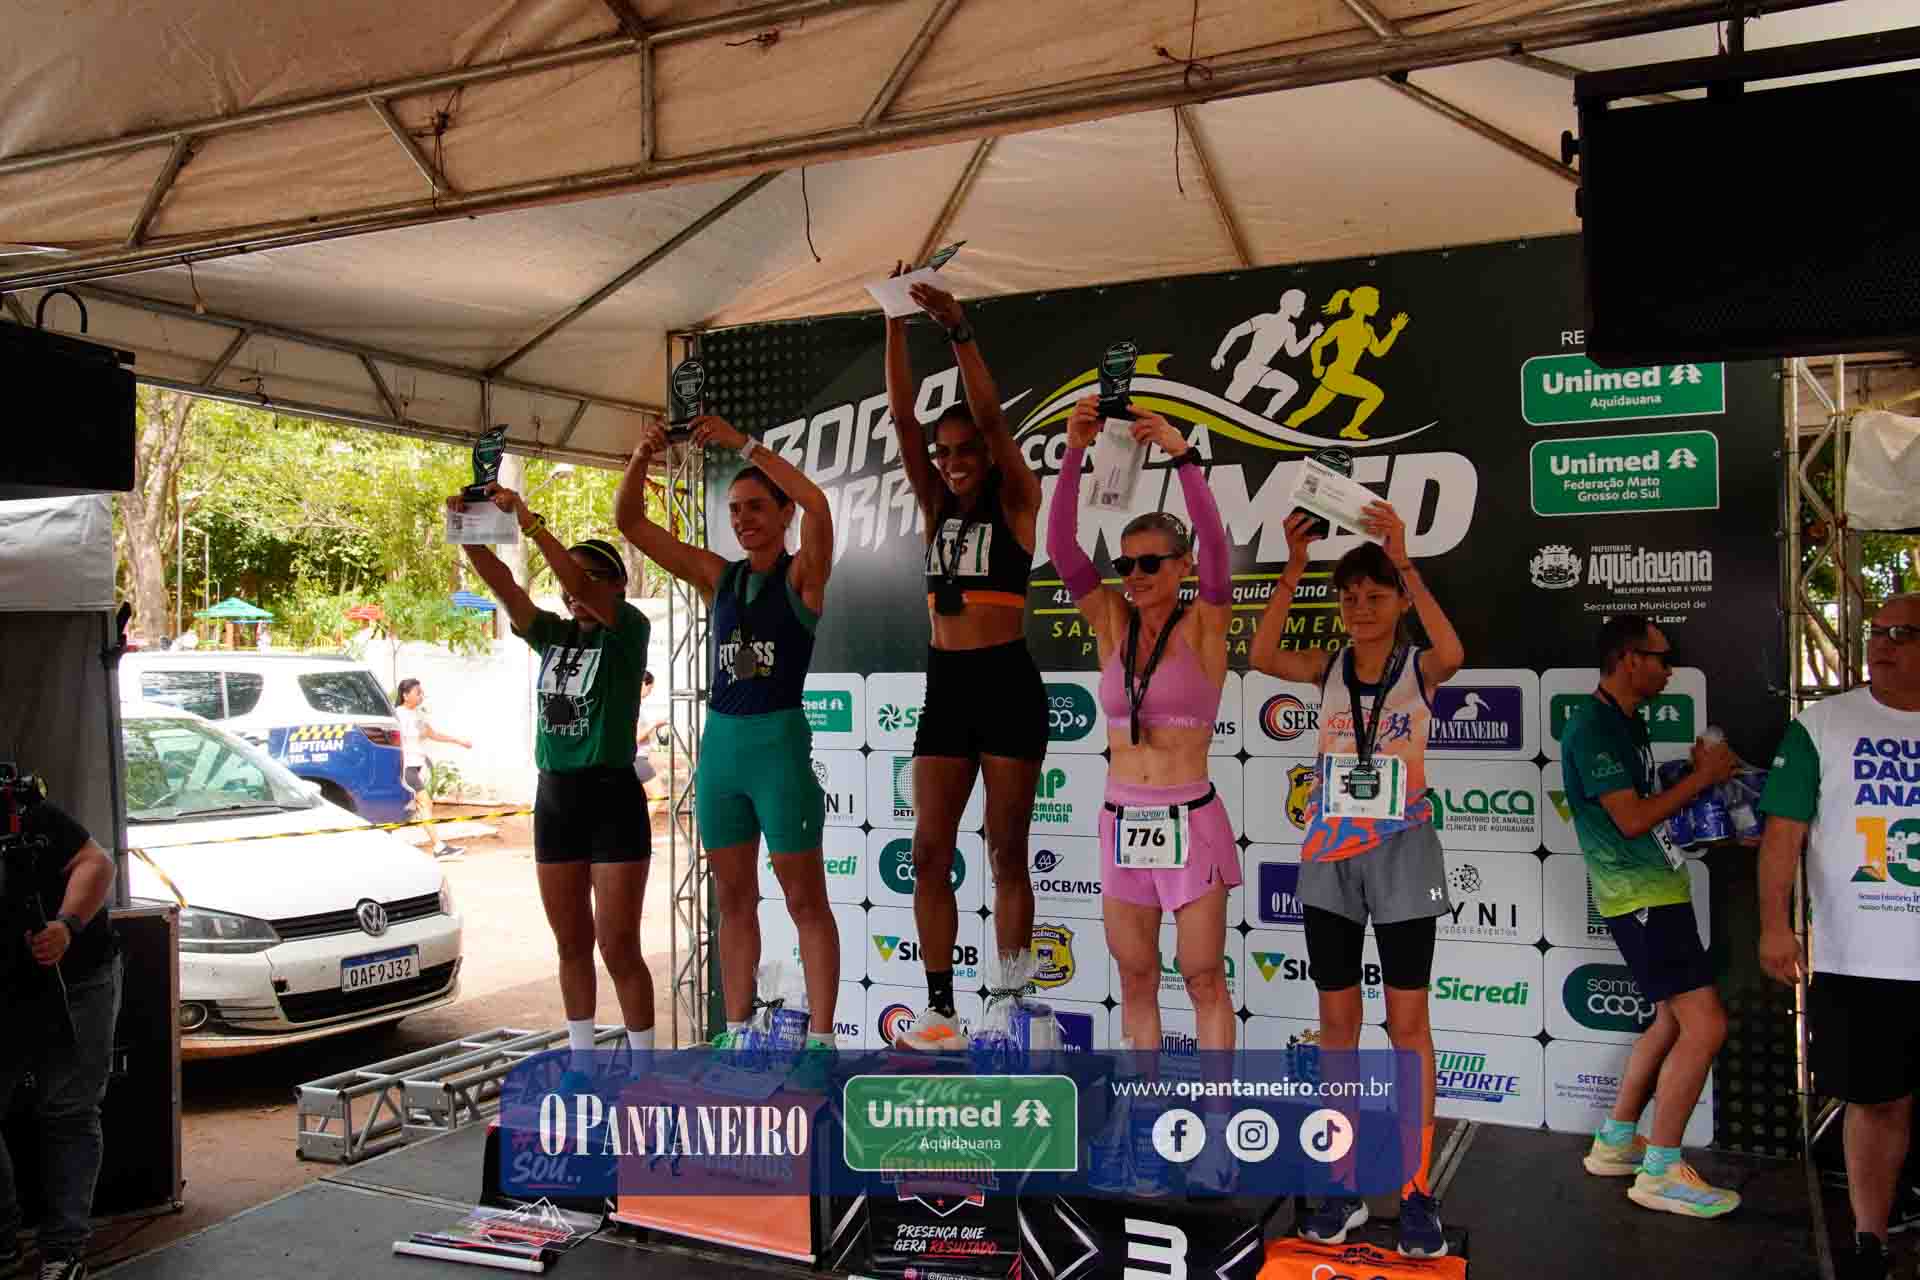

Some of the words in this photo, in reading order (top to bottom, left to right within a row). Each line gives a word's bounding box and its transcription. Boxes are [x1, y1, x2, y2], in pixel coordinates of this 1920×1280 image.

[1542, 365, 1662, 394] Unimed
[1590, 394, 1662, 409] Aquidauana
[1549, 450, 1661, 476] Unimed
[1563, 478, 1625, 492] Federação
[1627, 476, 1661, 488] Mato
[1577, 490, 1619, 502] Grosso
[1622, 489, 1638, 500] do
[1640, 488, 1661, 499] Sul
[1667, 585, 1682, 593] VER
[1690, 584, 1713, 592] VIVER
[1583, 602, 1638, 612] Secretaria
[1639, 600, 1691, 612] Municipal
[1693, 599, 1707, 609] de
[1655, 614, 1688, 624] Lazer
[1430, 717, 1509, 740] PANTANEIRO
[1031, 813, 1070, 823] OPULAR
[1126, 828, 1166, 847] 776
[1434, 976, 1529, 1007] Sicredi
[1437, 1070, 1521, 1093] SPORTE
[896, 1223, 958, 1241] PRESENÇA
[960, 1226, 986, 1240] QUE
[892, 1239, 927, 1252] GERA
[928, 1240, 998, 1256] RESULTADO
